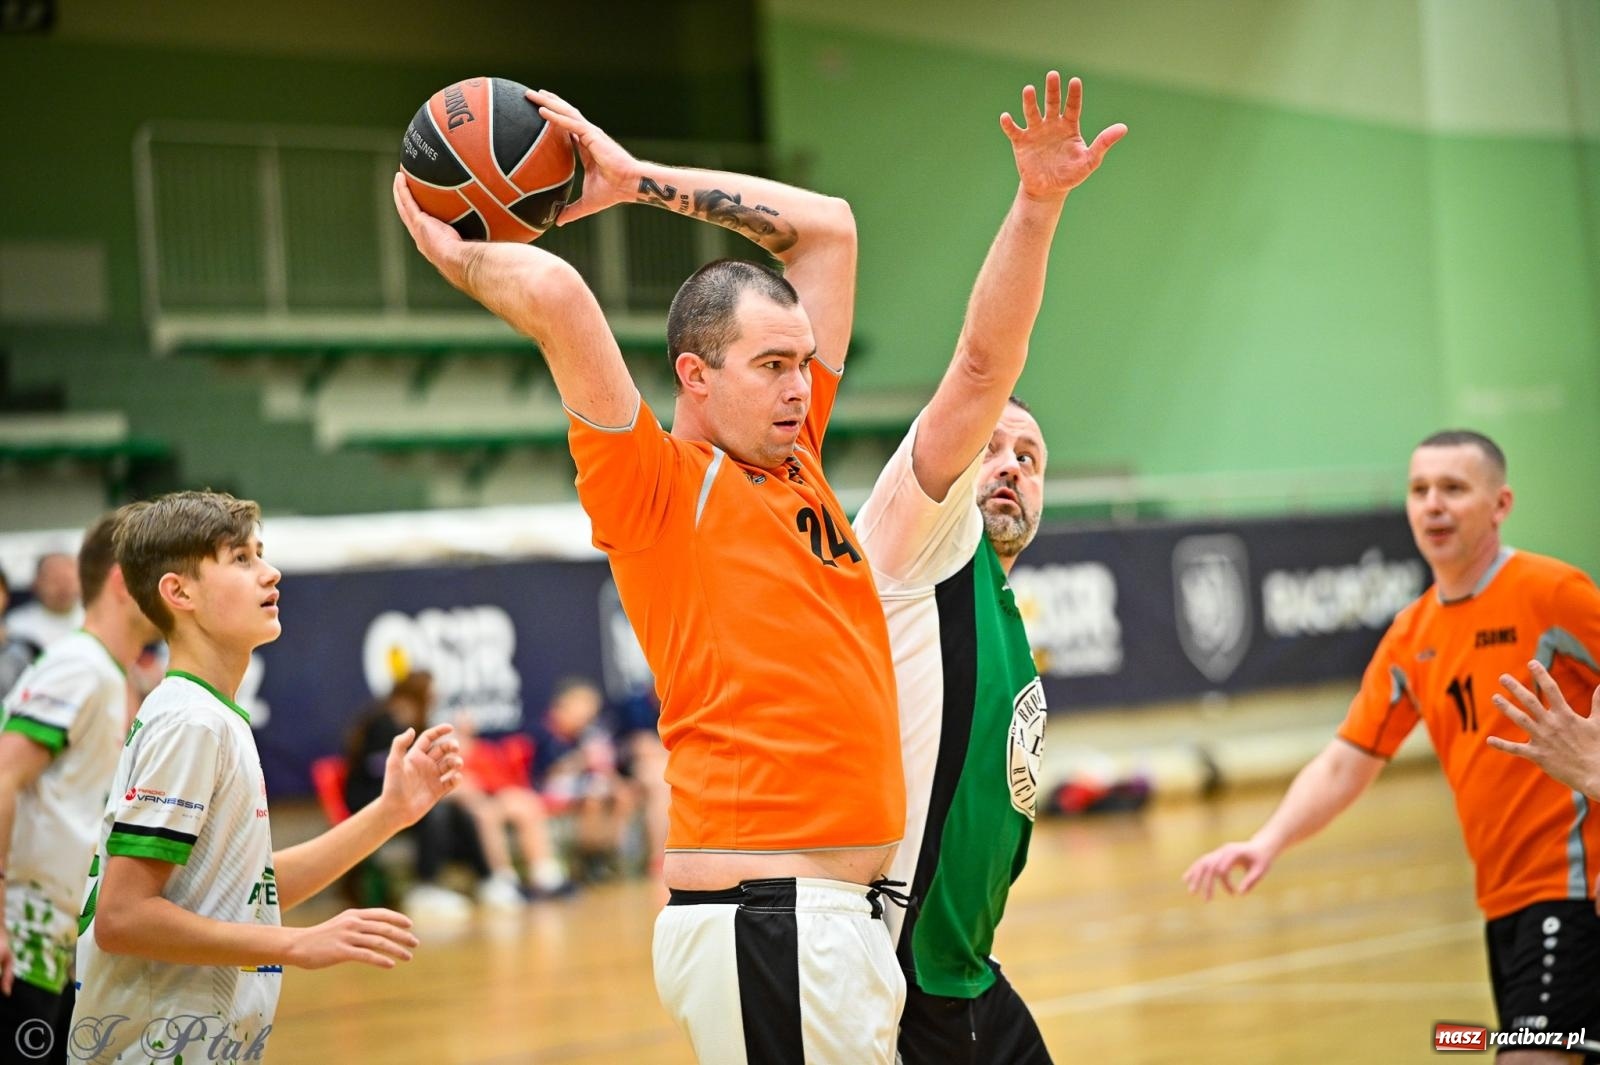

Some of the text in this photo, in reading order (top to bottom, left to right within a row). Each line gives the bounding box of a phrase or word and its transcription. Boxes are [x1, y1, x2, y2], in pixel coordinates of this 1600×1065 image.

[410, 130, 439, 161] AIRLINES
[796, 503, 862, 568] 24
[1446, 675, 1477, 734] 11
[137, 794, 205, 812] VANESSA
